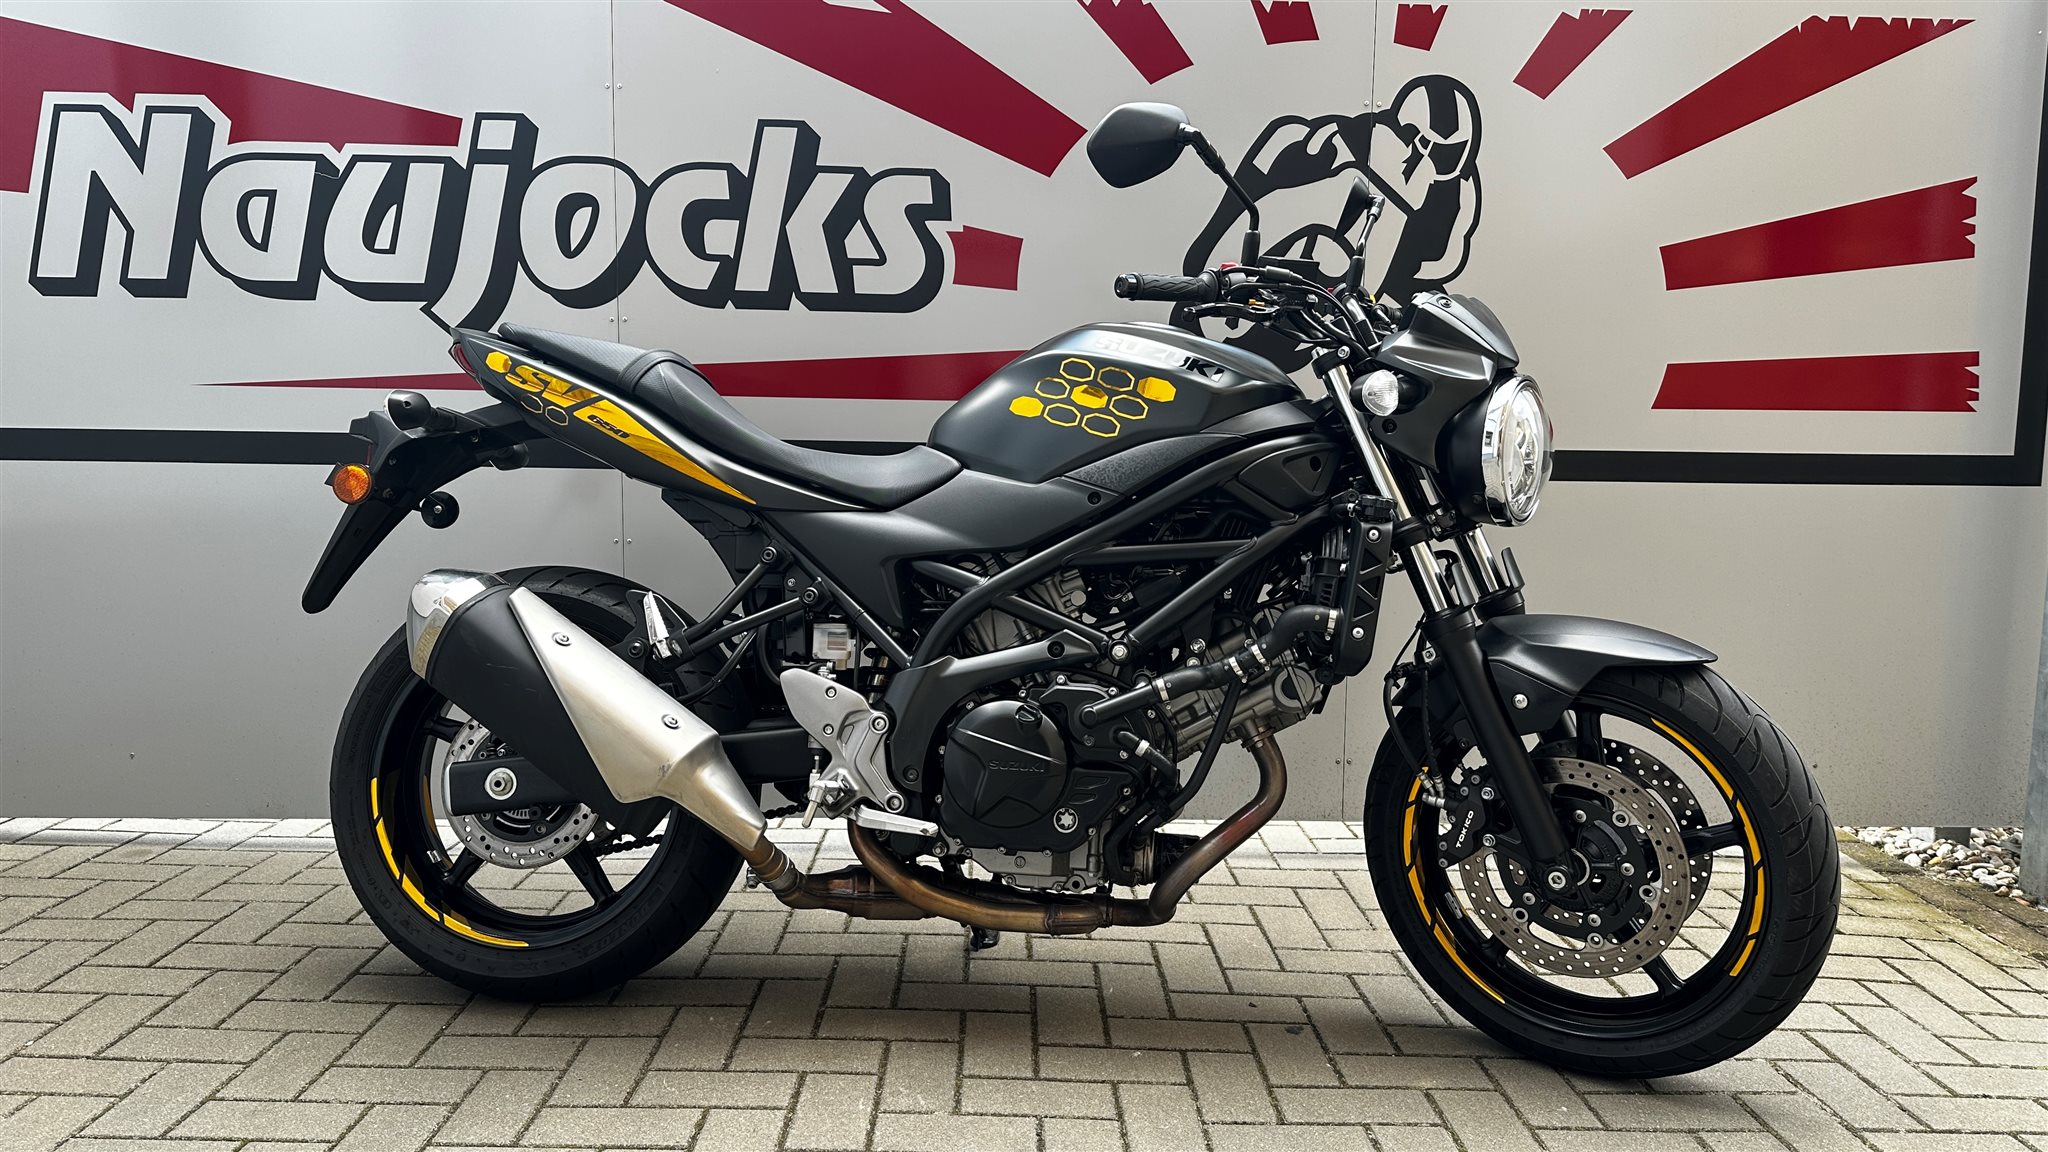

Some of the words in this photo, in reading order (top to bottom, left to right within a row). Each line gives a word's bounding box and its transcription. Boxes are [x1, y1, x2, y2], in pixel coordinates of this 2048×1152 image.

[29, 103, 952, 333] Naujocks
[1095, 335, 1227, 383] SUZUKI
[505, 365, 599, 408] SV
[587, 414, 630, 438] 650
[989, 760, 1045, 773] SUZUKI
[1455, 810, 1474, 848] TOKICO
